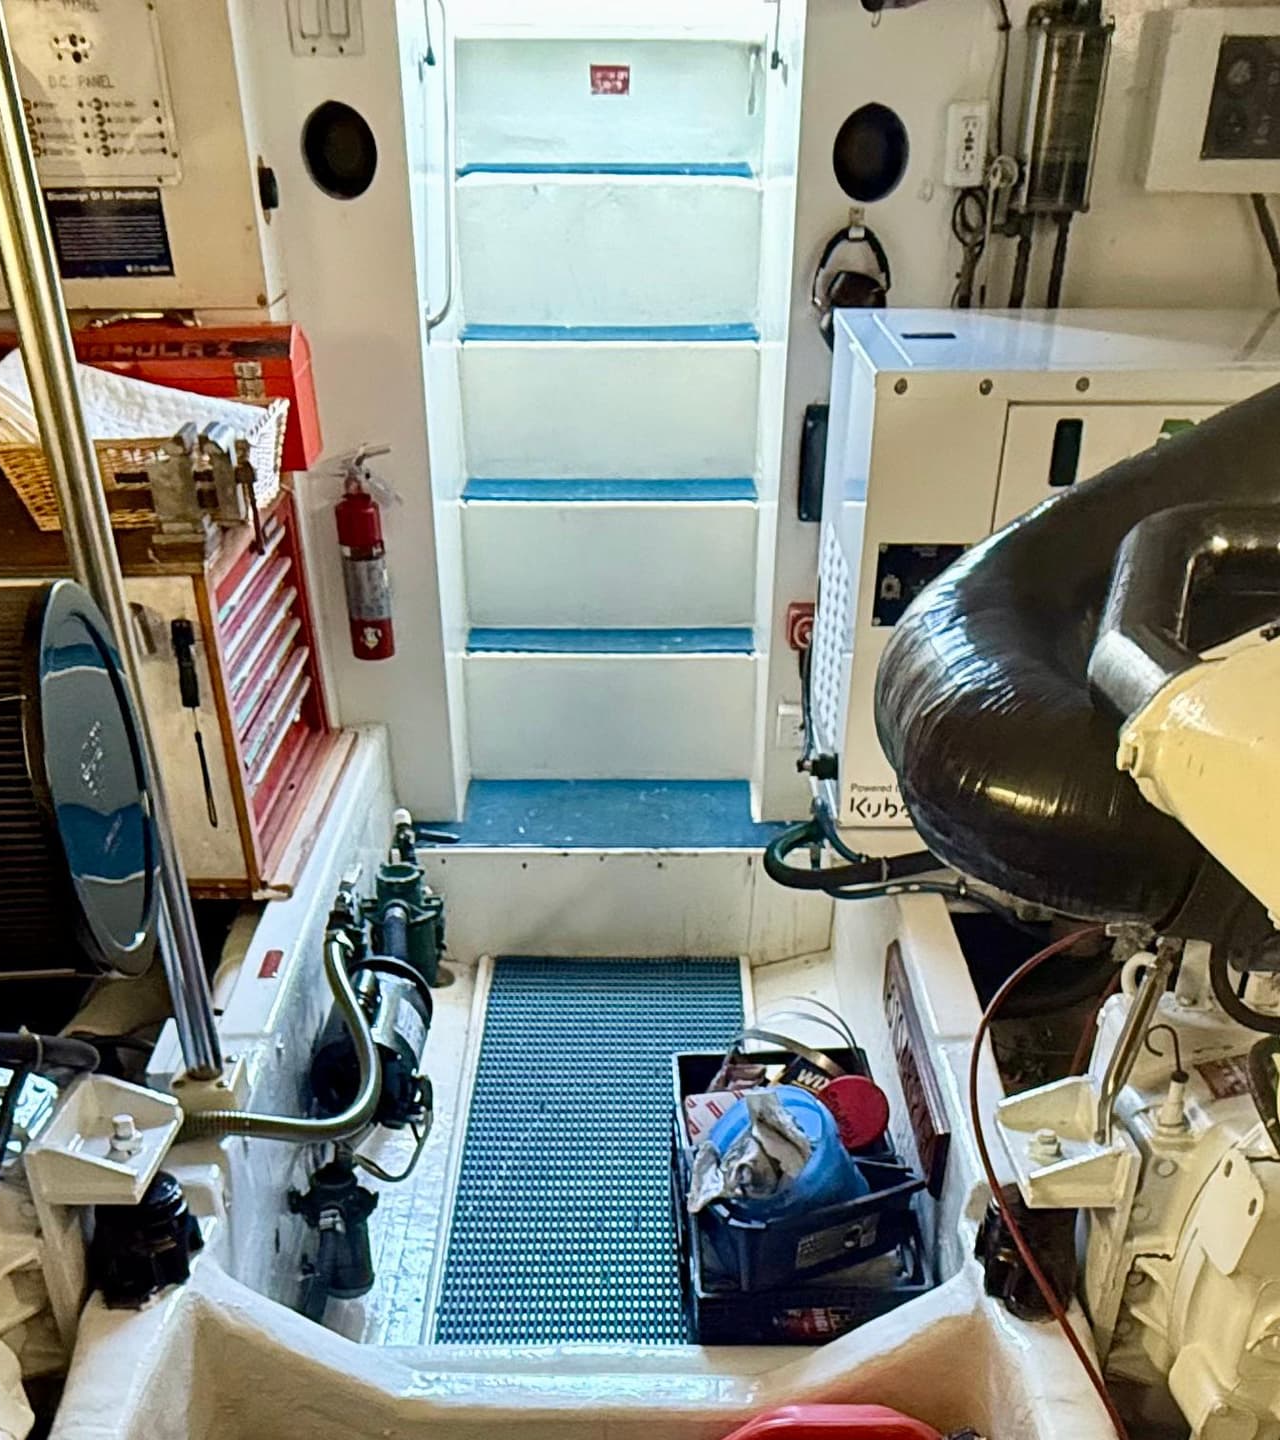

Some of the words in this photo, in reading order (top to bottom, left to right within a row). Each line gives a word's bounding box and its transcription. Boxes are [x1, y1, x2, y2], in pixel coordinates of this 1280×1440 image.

[77, 74, 116, 89] PANEL
[115, 191, 158, 200] Prohibited
[851, 783, 892, 793] Powered
[850, 796, 911, 818] Kubo
